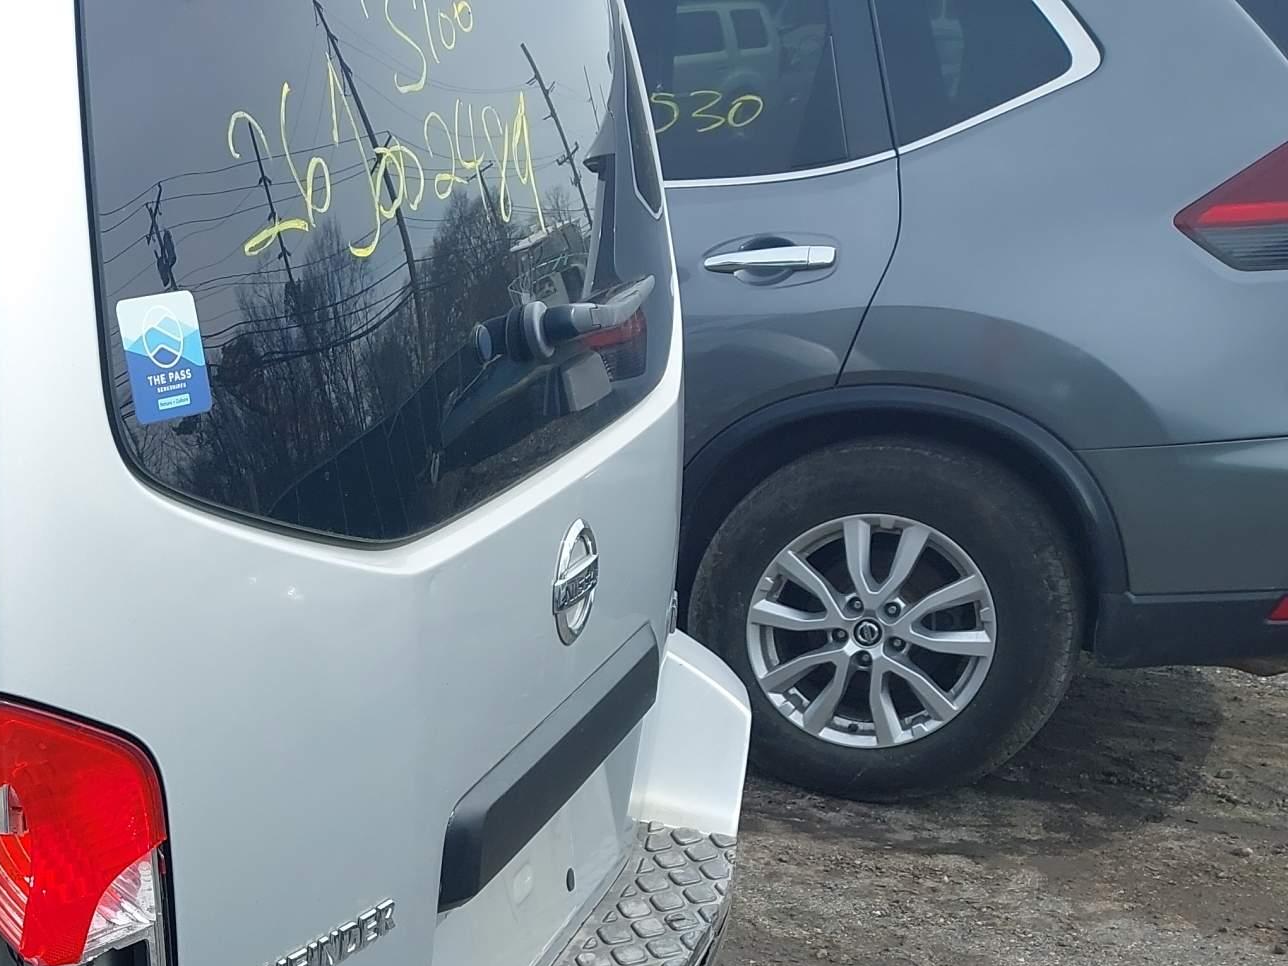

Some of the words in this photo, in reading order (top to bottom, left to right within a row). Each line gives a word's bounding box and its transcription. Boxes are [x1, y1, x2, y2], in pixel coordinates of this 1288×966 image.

[651, 90, 764, 133] 530
[147, 373, 167, 386] THE
[168, 368, 192, 383] PASS
